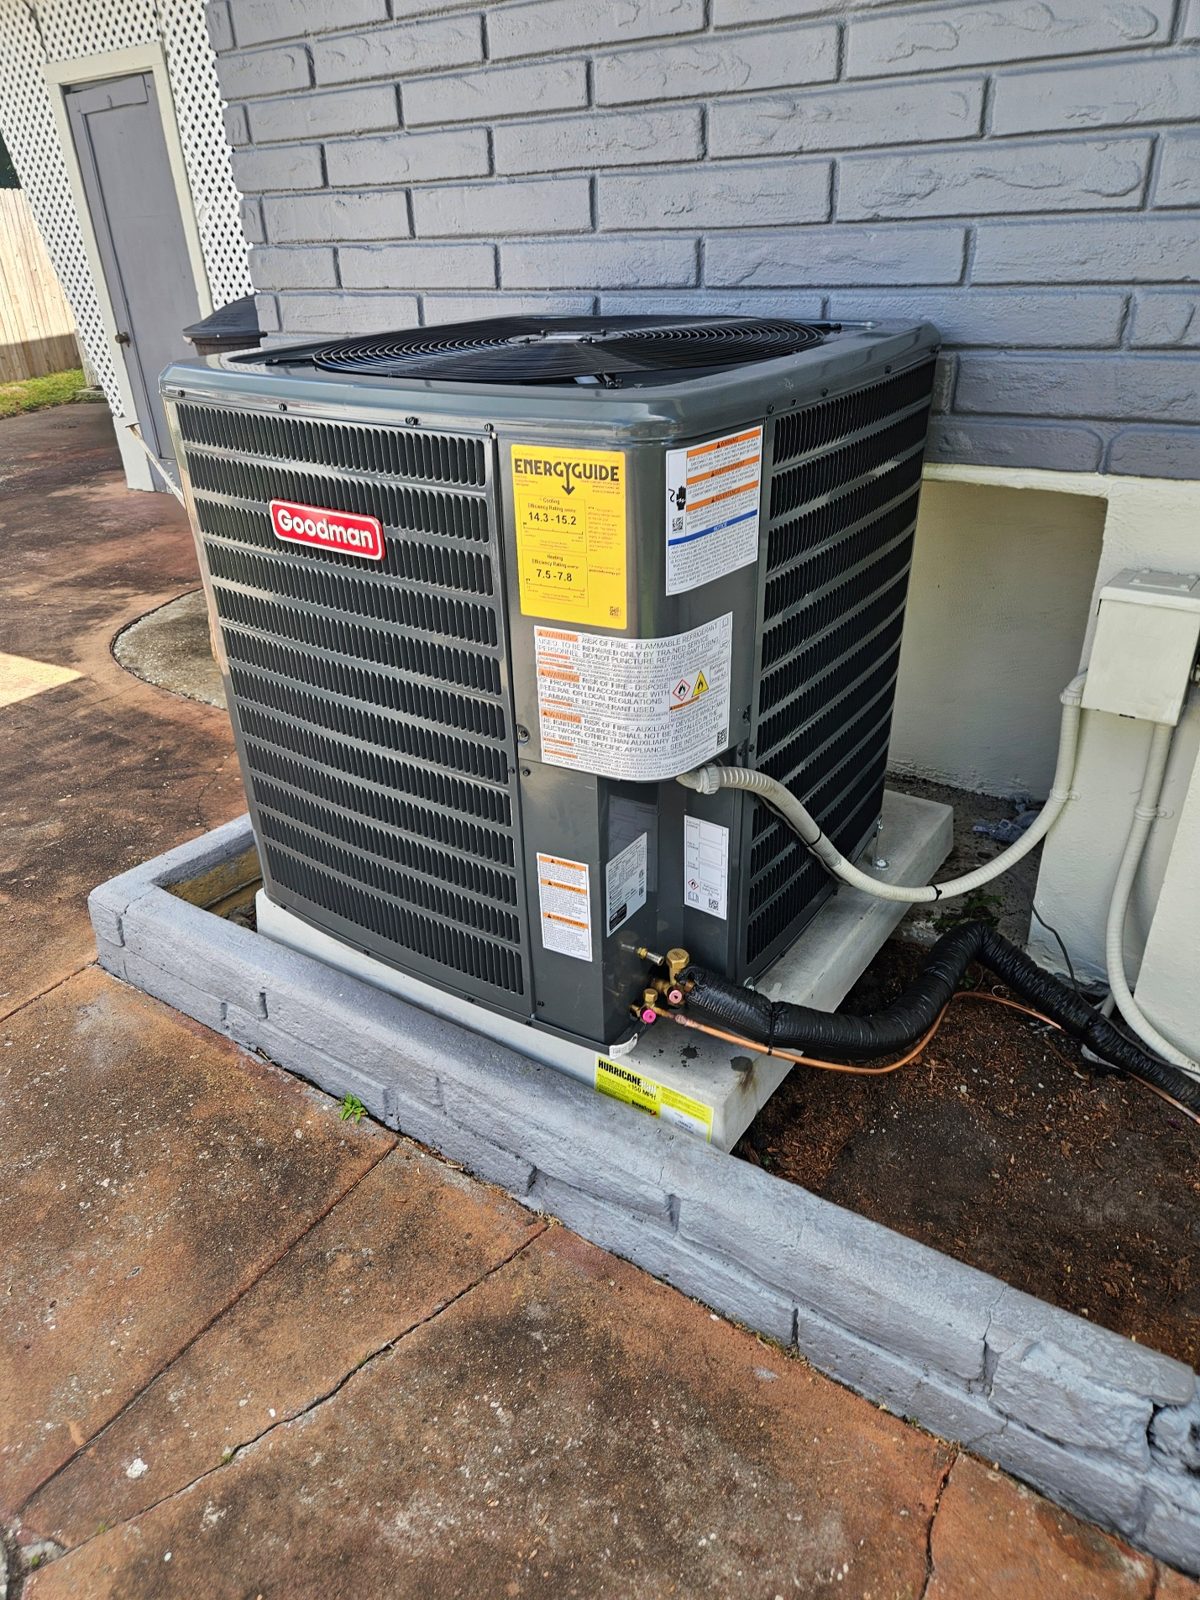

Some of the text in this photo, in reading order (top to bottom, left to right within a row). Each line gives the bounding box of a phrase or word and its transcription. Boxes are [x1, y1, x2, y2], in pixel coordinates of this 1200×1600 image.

[514, 458, 620, 485] ENERGYGUIDE
[527, 502, 548, 510] Efficiency
[548, 505, 564, 513] Rating
[543, 497, 560, 505] Cooling
[528, 511, 549, 523] 14.3
[555, 514, 577, 526] 15.2
[277, 508, 374, 549] Goodman
[531, 558, 567, 569] Efficiency Rating
[536, 568, 551, 579] 7.5
[557, 571, 573, 582] 7.8
[581, 637, 599, 645] RISK
[599, 639, 608, 647] OF
[610, 640, 629, 649] FIRE
[635, 640, 681, 650] FLAMMABLE
[681, 623, 718, 641] REFRIGERANT
[582, 645, 619, 656] REPAIRED
[620, 650, 641, 658] ONLY
[657, 645, 687, 657] TRAINED
[687, 634, 709, 647] SERVICE
[611, 656, 652, 665] PUNCTURE
[656, 646, 701, 664] REFRIGERANT
[549, 679, 586, 690] PROPERLY
[596, 687, 648, 698] ACCORDANCE
[650, 690, 670, 698] WITH
[582, 677, 599, 686] RISK
[599, 680, 609, 688] OF
[611, 681, 627, 690] FIRE
[635, 682, 669, 691] DISPOSE
[540, 692, 580, 704] FLAMMABLE
[581, 699, 631, 712] REFRIGERANT
[572, 689, 584, 697] OR
[584, 691, 606, 700] LOCAL
[553, 719, 583, 730] IGNITION
[583, 725, 617, 737] SOURCES
[618, 732, 643, 740] SHALL
[674, 721, 702, 734] INSTALLED
[708, 710, 717, 718] THE
[584, 719, 600, 727] RISK
[612, 723, 630, 732] FIRE
[636, 724, 675, 732] AUXILIARY
[675, 714, 698, 728] DEVICES
[715, 699, 727, 708] MAY
[584, 733, 609, 742] OTHER
[609, 736, 629, 745] THAN
[630, 738, 669, 746] AUXILIARY
[671, 728, 695, 743] DEVICES
[695, 719, 713, 732] LISTED
[713, 713, 723, 722] FOR
[558, 734, 576, 742] WITH
[577, 737, 590, 745] THE
[591, 740, 623, 752] SPECIFIC
[670, 742, 683, 750] SEE
